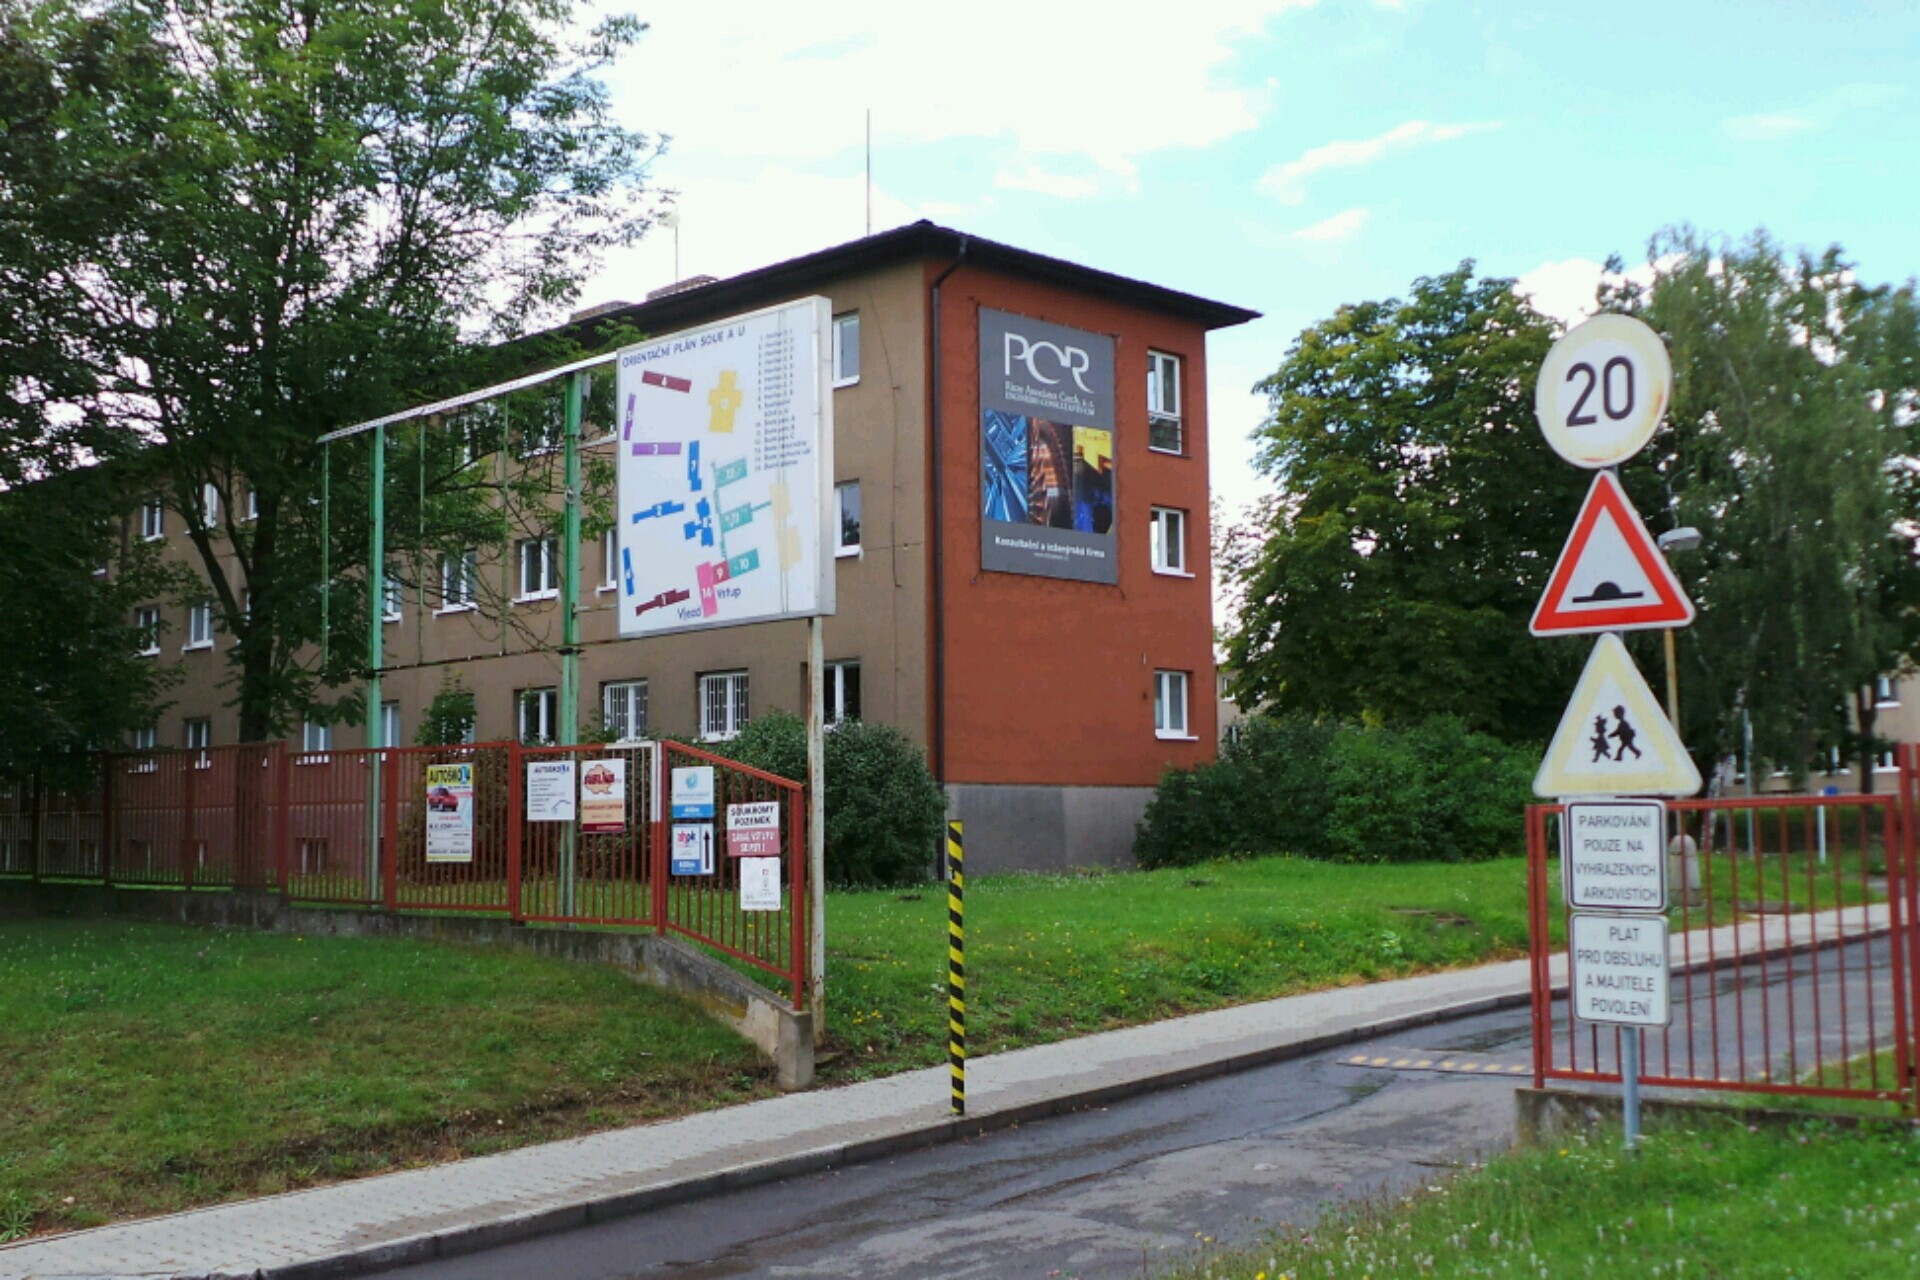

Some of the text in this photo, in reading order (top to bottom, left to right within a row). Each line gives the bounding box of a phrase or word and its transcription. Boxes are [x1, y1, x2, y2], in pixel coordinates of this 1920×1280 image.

[622, 344, 670, 368] ORIENTAČNÍ
[673, 339, 696, 354] PLÁN
[1566, 355, 1634, 427] 20
[734, 816, 771, 827] POZEMEK
[1583, 839, 1645, 853] POUZE NA
[1577, 948, 1662, 968] PRO OBSLUHU
[1585, 973, 1655, 993] A MAJITELE
[1590, 996, 1652, 1016] POVOLENÍ
